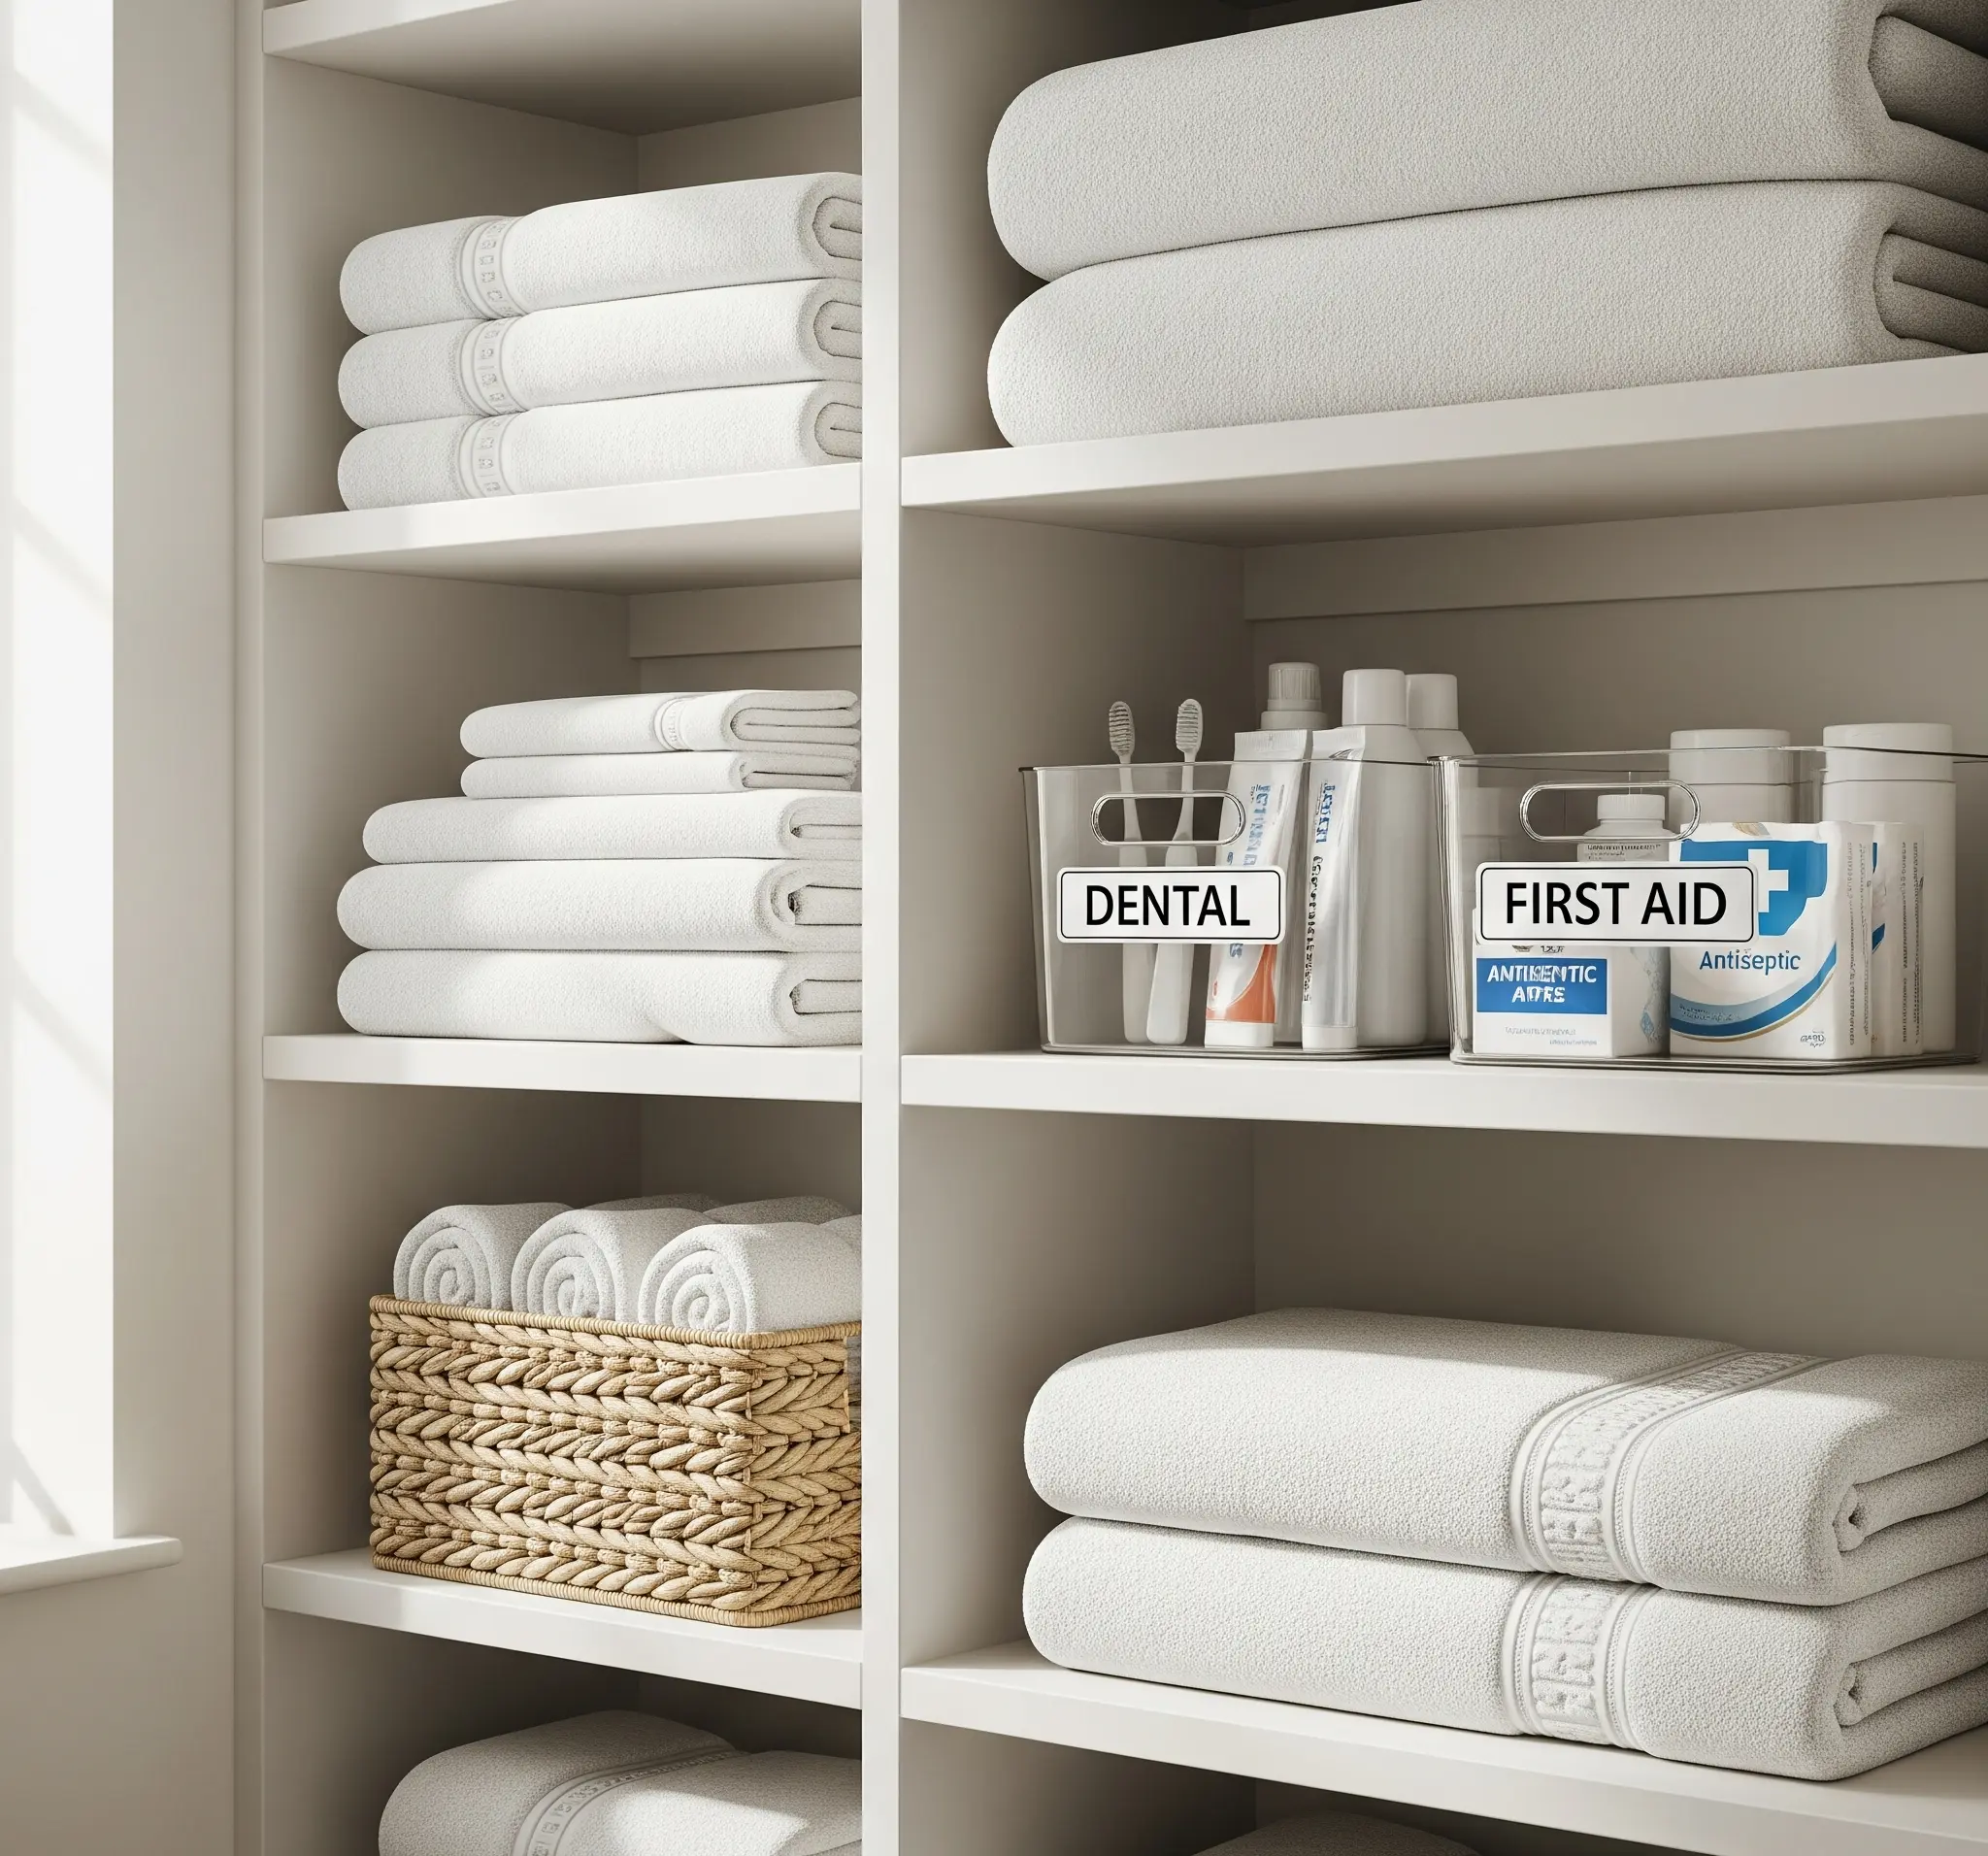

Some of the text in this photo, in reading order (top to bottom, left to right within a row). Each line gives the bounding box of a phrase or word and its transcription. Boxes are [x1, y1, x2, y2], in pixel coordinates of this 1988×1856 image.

[1086, 884, 1250, 926] DENTAL
[1507, 881, 1727, 926] FIRST AID
[1699, 948, 1802, 976] Antiseptic
